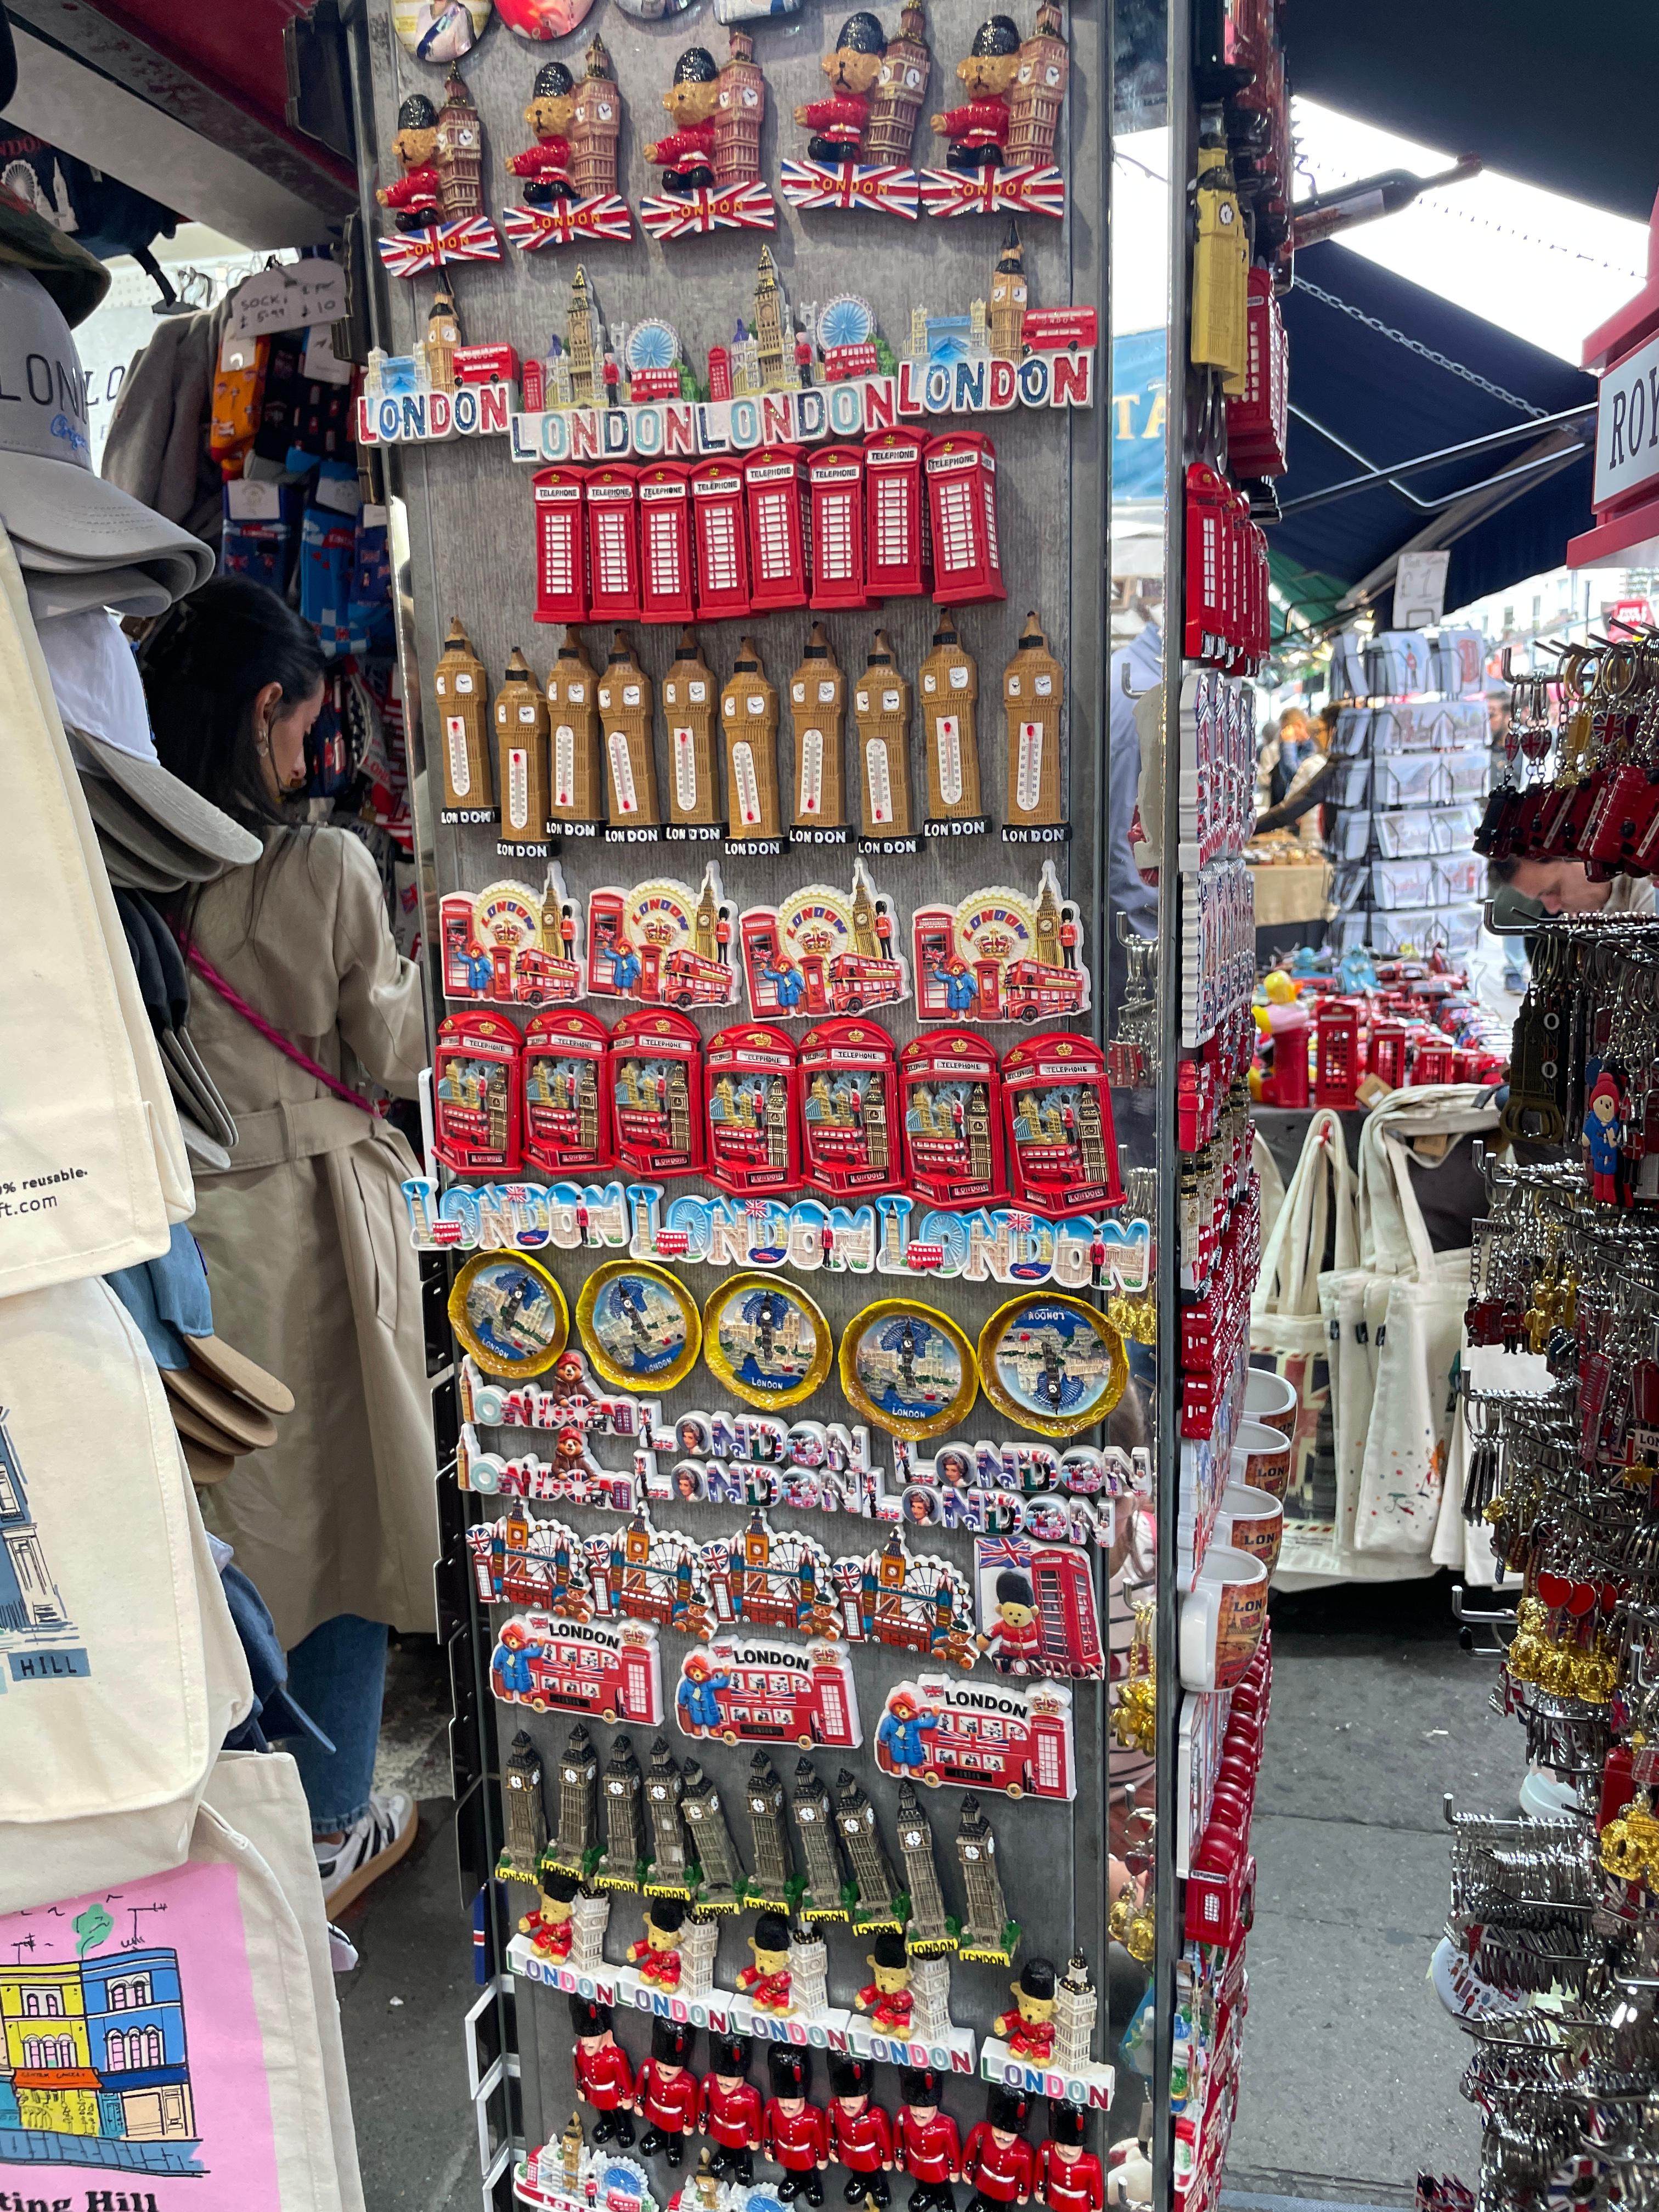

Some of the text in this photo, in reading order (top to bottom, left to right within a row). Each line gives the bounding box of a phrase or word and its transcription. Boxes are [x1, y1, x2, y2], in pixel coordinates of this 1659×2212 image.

[810, 180, 889, 196] LONDON
[950, 183, 1033, 198] LONDON
[669, 201, 744, 219] LONDON
[531, 212, 602, 229] LONDON
[404, 236, 470, 257] LONDON
[898, 354, 1090, 413] LONDON
[358, 386, 509, 443] LONDON
[697, 380, 895, 450] LONDON
[511, 405, 692, 460] LONDON
[871, 450, 915, 460] TELEPHONE
[929, 454, 975, 470] TELEPHONE
[750, 466, 792, 478] TELEPHONE
[815, 467, 857, 478] TELEPHONE
[539, 489, 577, 497] TELEPHONE
[644, 487, 682, 495] TELEPHONE
[697, 481, 738, 492] TELEPHONE
[481, 900, 535, 931] LONDON
[631, 898, 690, 931] LONDON
[786, 906, 848, 939] LONDON
[962, 909, 1029, 942] LONDON
[469, 1041, 505, 1052] TELEPHONE
[646, 1039, 683, 1049] TELEPHONE
[746, 1054, 781, 1064] TELEPHONE
[838, 1051, 878, 1060] TELEPHONE
[941, 1062, 981, 1070] TELEPHONE
[654, 1156, 687, 1165] LONDON
[22, 1167, 88, 1190] reusable.
[751, 1173, 784, 1183] LONDON
[851, 1173, 884, 1183] LONDON
[955, 1185, 989, 1196] LONDON
[1069, 1189, 1104, 1203] LONDON
[401, 1177, 630, 1251] LONDON
[627, 1182, 876, 1274] LONDON
[1474, 1222, 1515, 1235] LONDON
[876, 1194, 1150, 1293] LONDON
[1028, 1311, 1065, 1321] LONDON
[481, 1338, 510, 1361] LONDON
[644, 1357, 673, 1373] LONDON
[751, 1376, 784, 1390] LONDON
[891, 1407, 926, 1419] LONDON
[639, 1398, 871, 1472] LONDON
[893, 1437, 1152, 1498] LONDON
[634, 1448, 863, 1513] LONDON
[862, 1467, 1115, 1549] LONDON
[549, 1622, 620, 1650] LONDON
[20, 1656, 77, 1677] HILL
[733, 1649, 810, 1671] LONDON
[992, 1656, 1104, 1681] LONDON
[945, 1690, 1028, 1719] LONDON
[496, 1871, 536, 1886] LONDON
[543, 1862, 581, 1881] LONDON
[597, 1878, 636, 1892] LONDON
[646, 1887, 686, 1901] LONDON
[697, 1904, 736, 1915] LONDON
[746, 1898, 788, 1915] LONDON
[804, 1912, 847, 1923] LONDON
[855, 1923, 899, 1936] LONDON
[910, 1939, 957, 1955] LONDON
[962, 1951, 1007, 1966] LONDON
[506, 1950, 616, 2007] LONDON
[614, 1981, 727, 2034] LONDON
[729, 2012, 847, 2052] LONDON
[848, 2034, 973, 2074] LONDON
[980, 2056, 1110, 2111] LONDON
[85, 2191, 159, 2212] Hill
